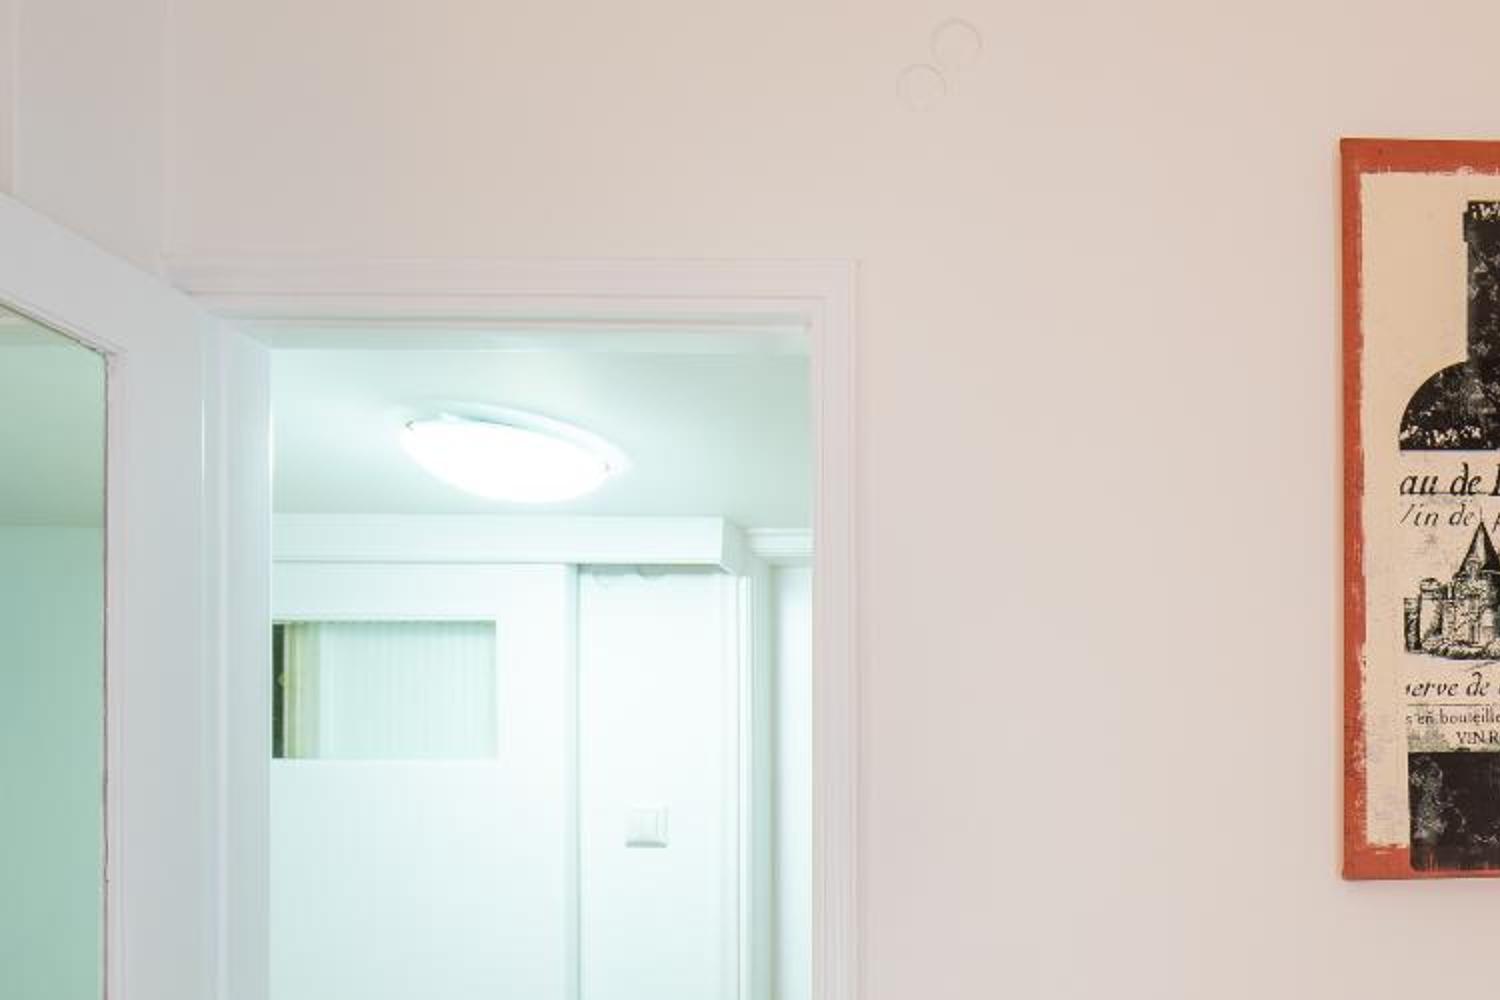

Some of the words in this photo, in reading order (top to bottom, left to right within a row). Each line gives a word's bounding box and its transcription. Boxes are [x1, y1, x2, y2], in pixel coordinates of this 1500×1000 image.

[1400, 475, 1439, 496] au
[1449, 462, 1482, 496] de
[1449, 503, 1476, 527] de
[1466, 672, 1490, 697] de
[1456, 730, 1486, 745] VIN
